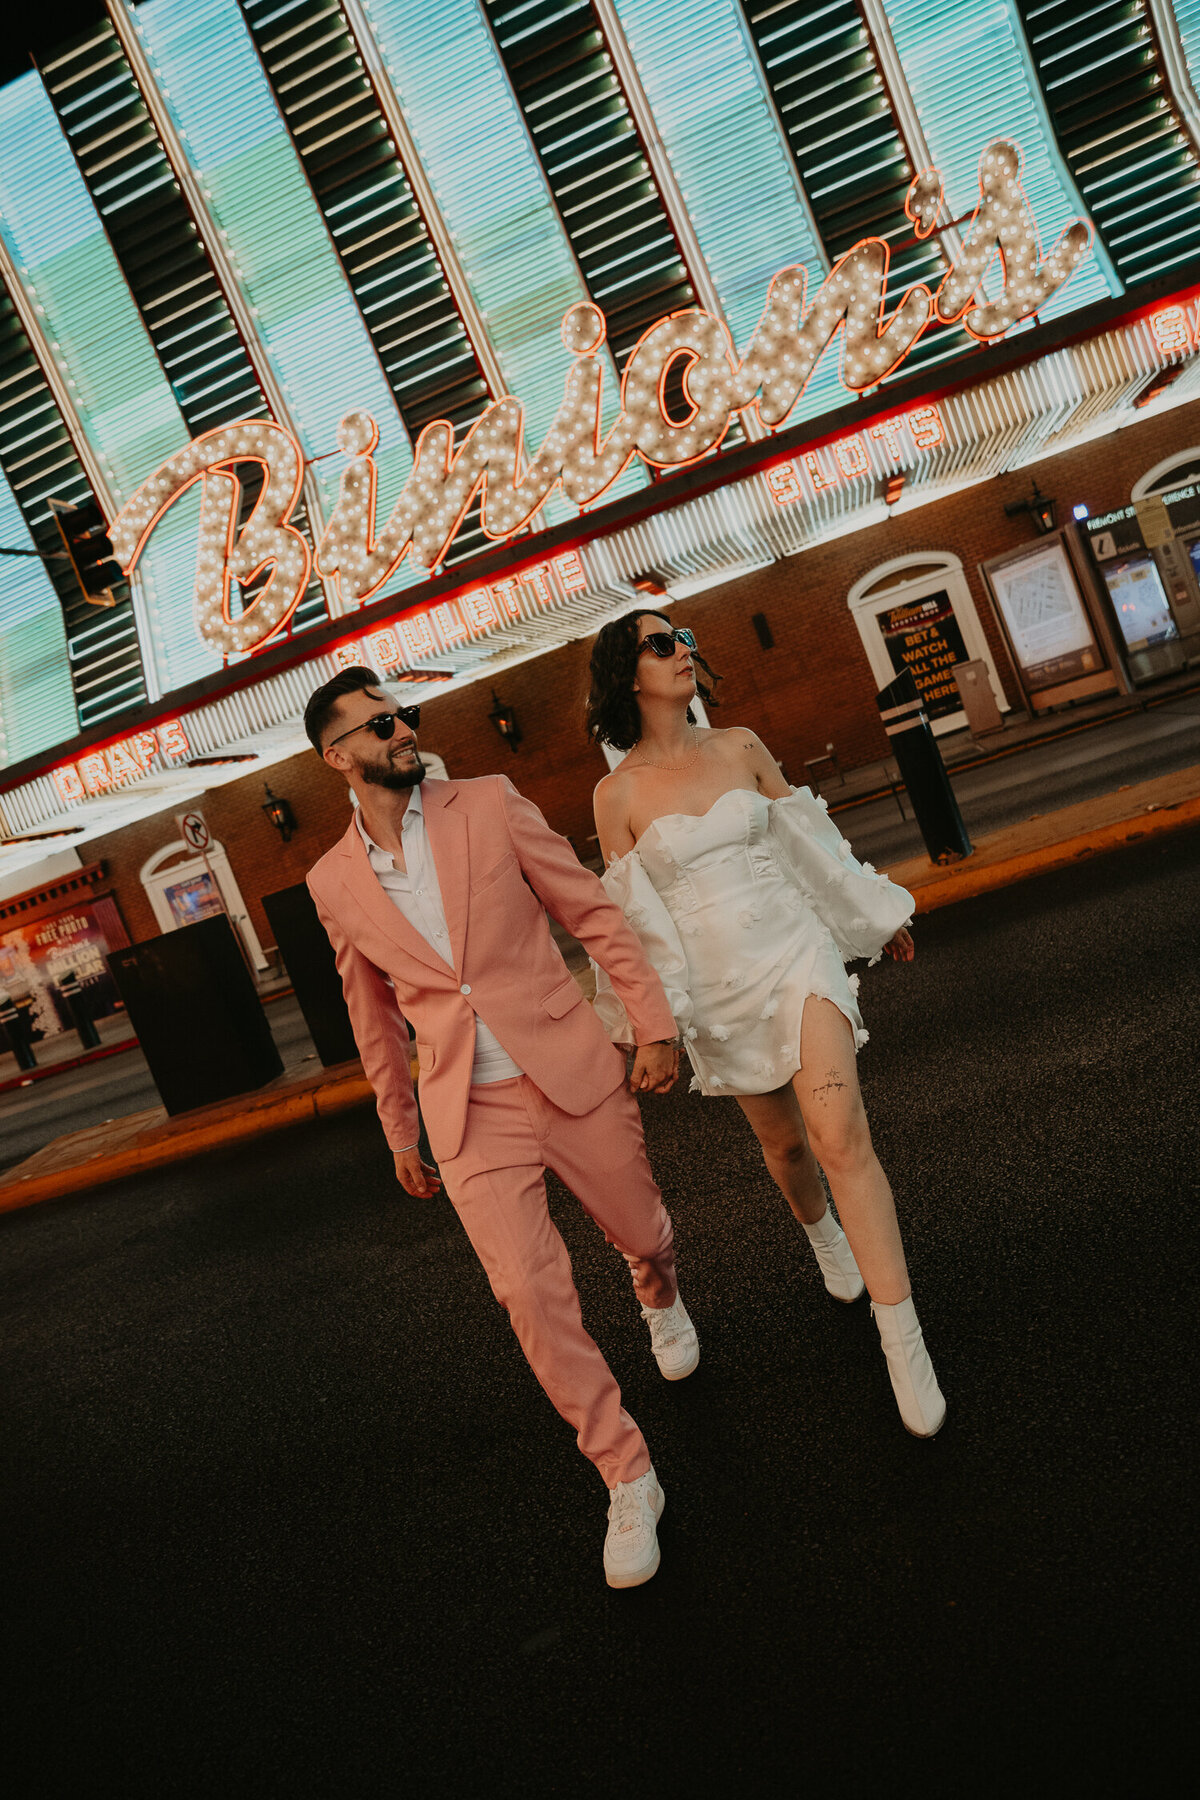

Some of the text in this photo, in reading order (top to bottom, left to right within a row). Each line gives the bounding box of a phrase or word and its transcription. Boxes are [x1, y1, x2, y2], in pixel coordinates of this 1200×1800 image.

[109, 137, 1095, 657] Binion's
[767, 404, 945, 507] SLOTS
[1087, 509, 1124, 530] FREMONT
[904, 627, 940, 647] BET &
[901, 639, 949, 663] WATCH
[930, 651, 957, 669] THE
[915, 669, 954, 690] GAME
[924, 681, 959, 702] HERE
[35, 916, 88, 946] FREE PHOTO
[45, 943, 101, 975] MILLION
